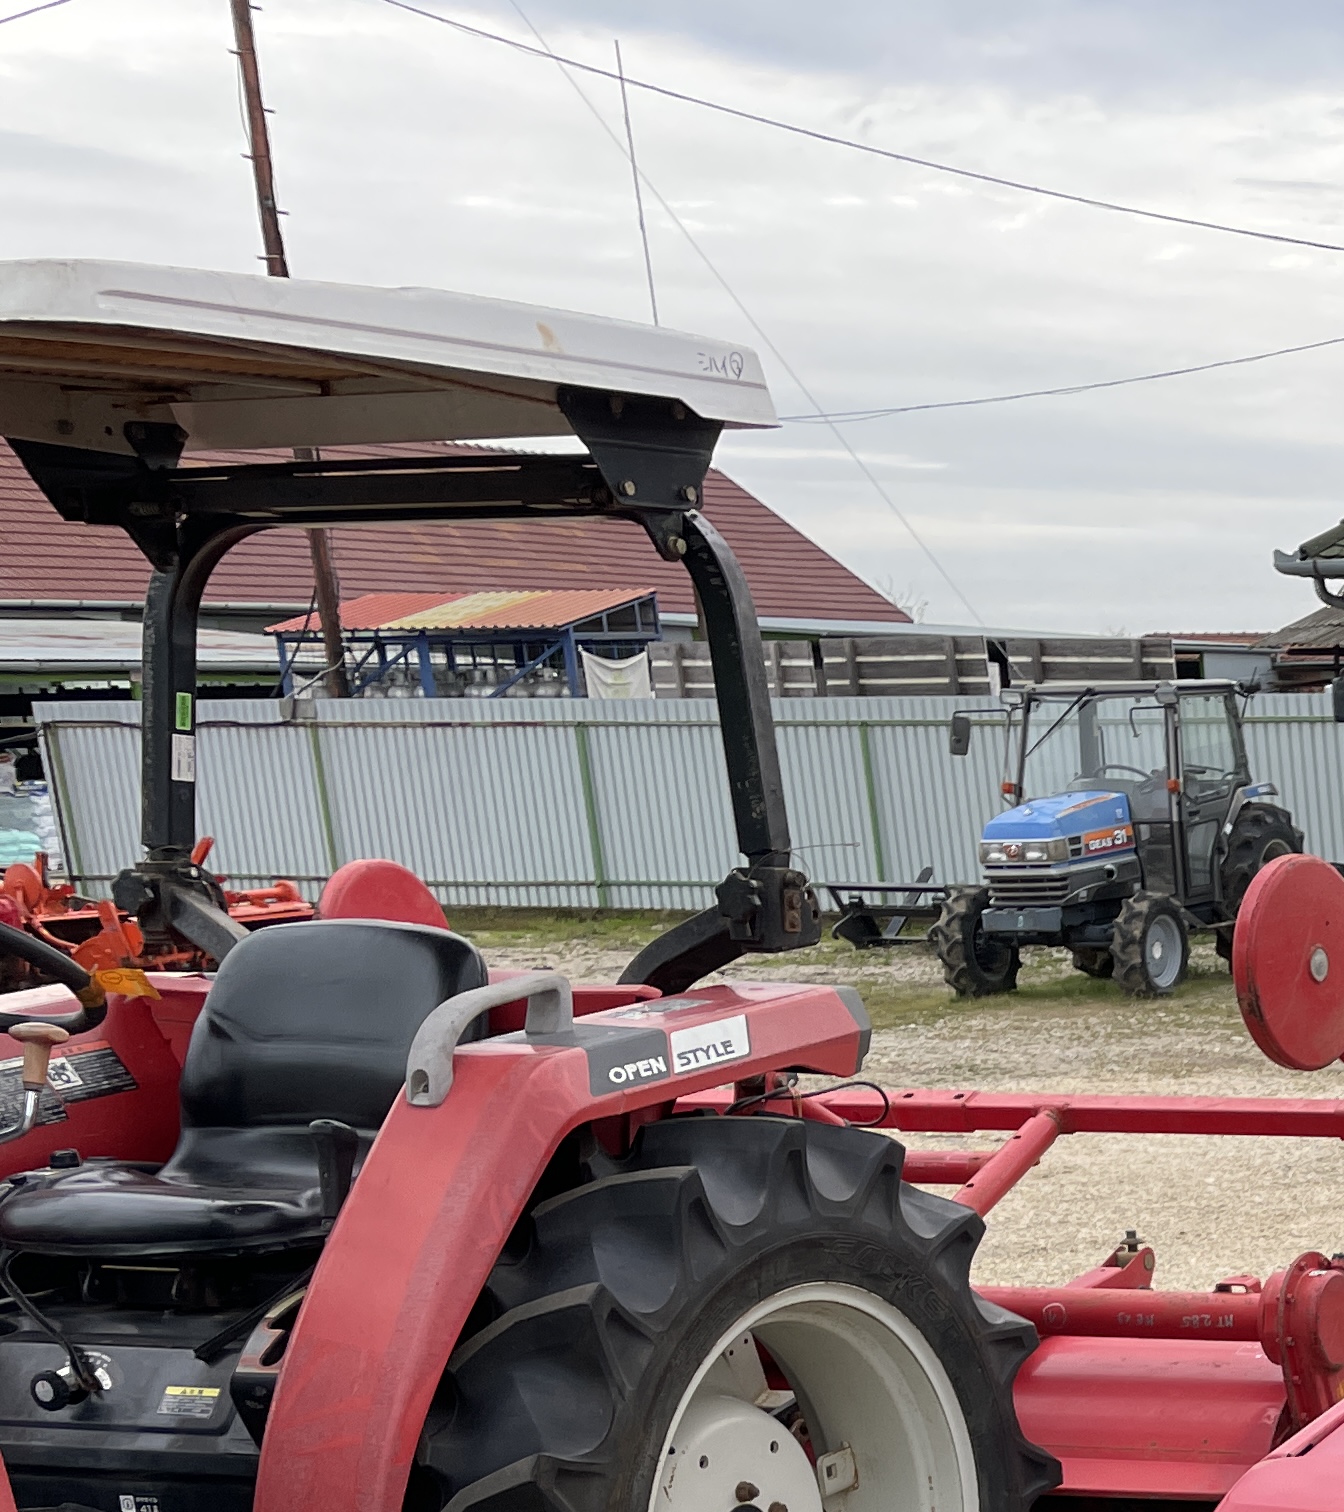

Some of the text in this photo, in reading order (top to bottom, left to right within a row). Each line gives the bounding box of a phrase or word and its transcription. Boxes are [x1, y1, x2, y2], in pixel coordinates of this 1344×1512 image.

[1113, 829, 1127, 845] 31
[608, 1039, 736, 1084] OPEN STYLE
